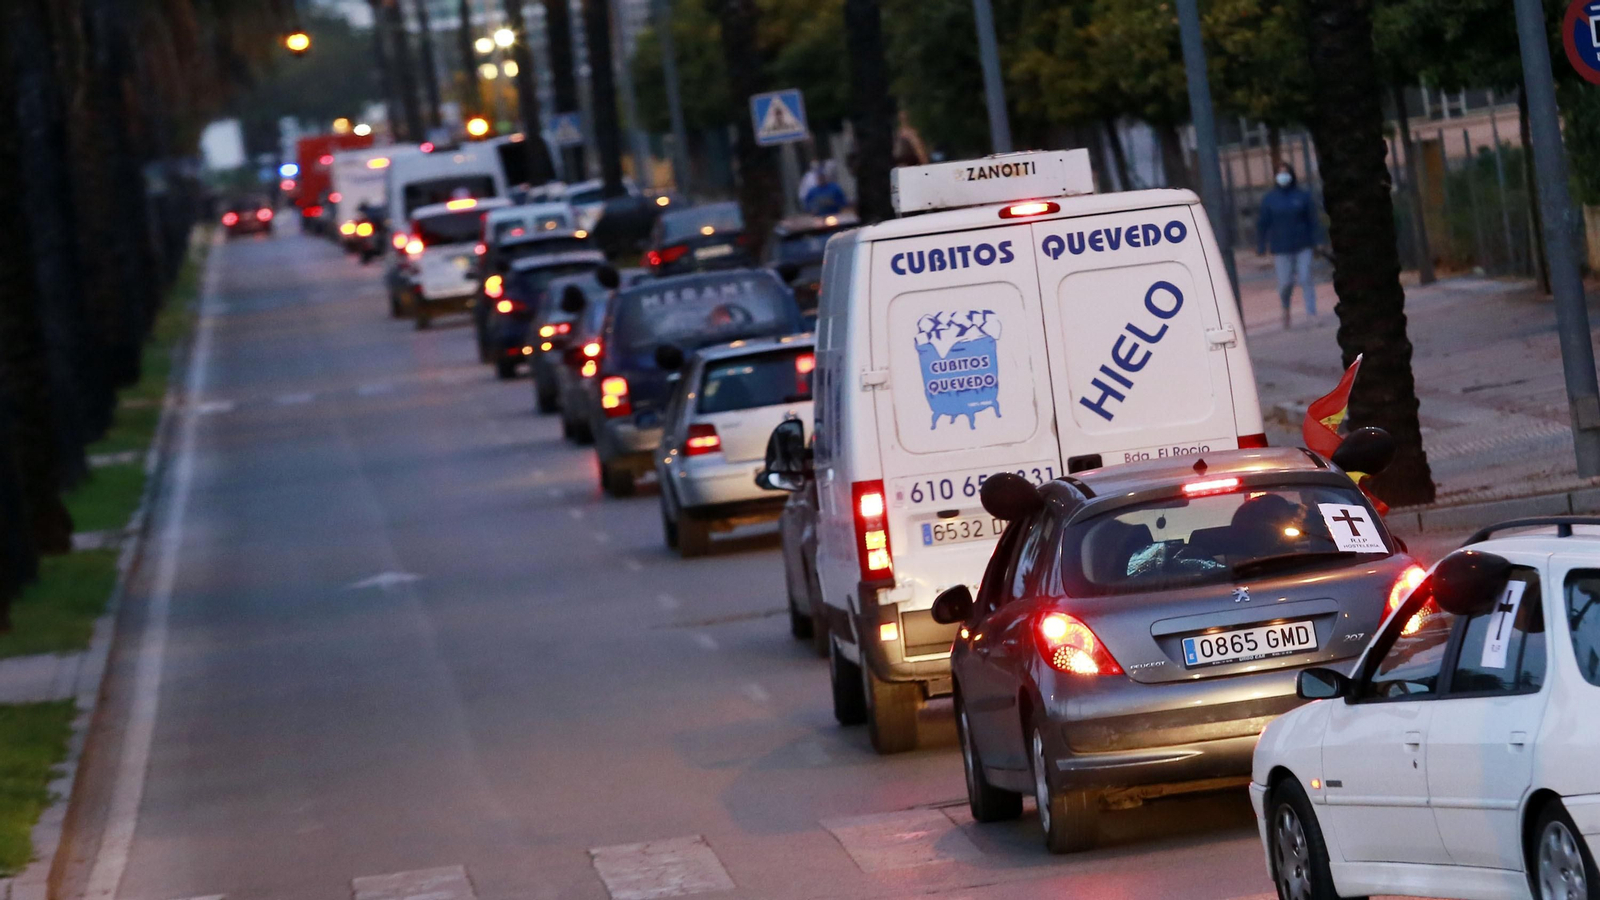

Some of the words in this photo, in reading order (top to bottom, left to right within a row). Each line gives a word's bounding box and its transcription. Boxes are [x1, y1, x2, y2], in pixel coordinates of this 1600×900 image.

[967, 161, 1036, 181] ZANOTTI
[890, 240, 1015, 276] CUBITOS
[1041, 220, 1187, 260] QUEVEDO
[1079, 280, 1184, 422] HIELO
[931, 356, 989, 373] CUBITOS
[928, 374, 995, 393] QUEVEDO
[911, 478, 954, 503] 610
[933, 520, 984, 542] 6532
[1200, 632, 1258, 658] 0865
[1266, 625, 1310, 649] GMD
[1343, 632, 1365, 642] 207
[1130, 660, 1166, 670] PEUGEOT
